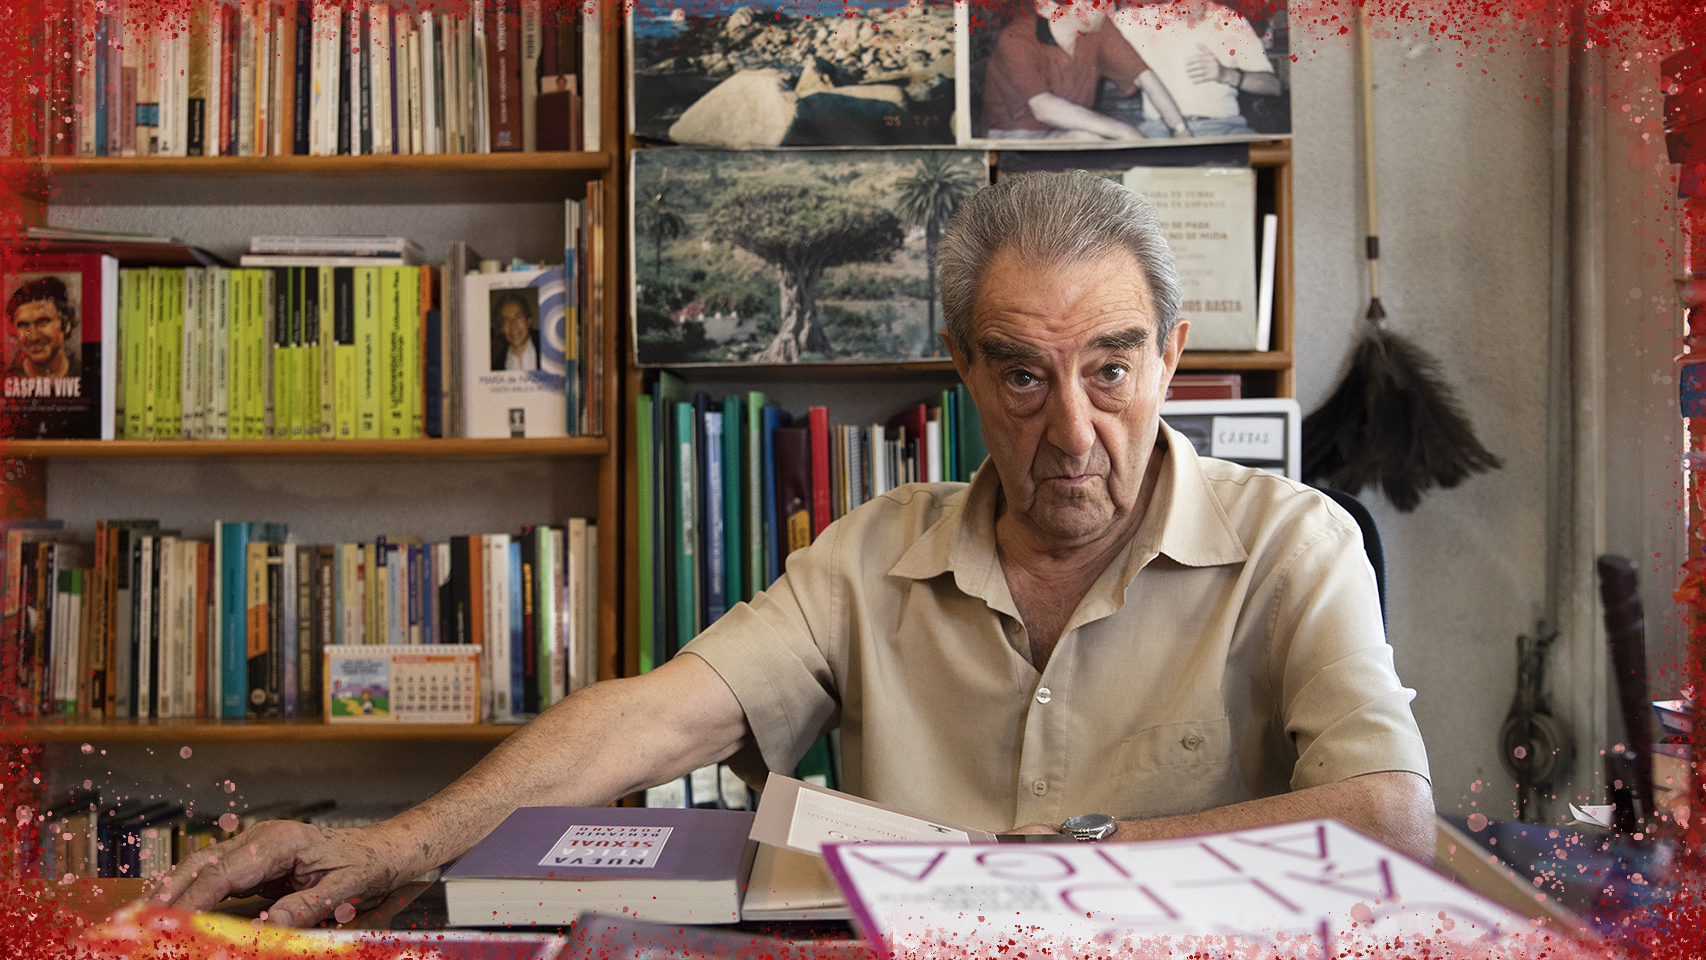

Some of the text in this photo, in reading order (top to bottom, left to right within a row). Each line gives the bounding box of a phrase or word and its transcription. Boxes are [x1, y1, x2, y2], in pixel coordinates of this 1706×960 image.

[1181, 300, 1243, 313] IOS BASTA
[4, 377, 82, 398] GASPAR VIVE
[568, 839, 654, 848] SEXUAL
[562, 848, 650, 858] ÉTICA
[553, 857, 645, 866] NUEVA
